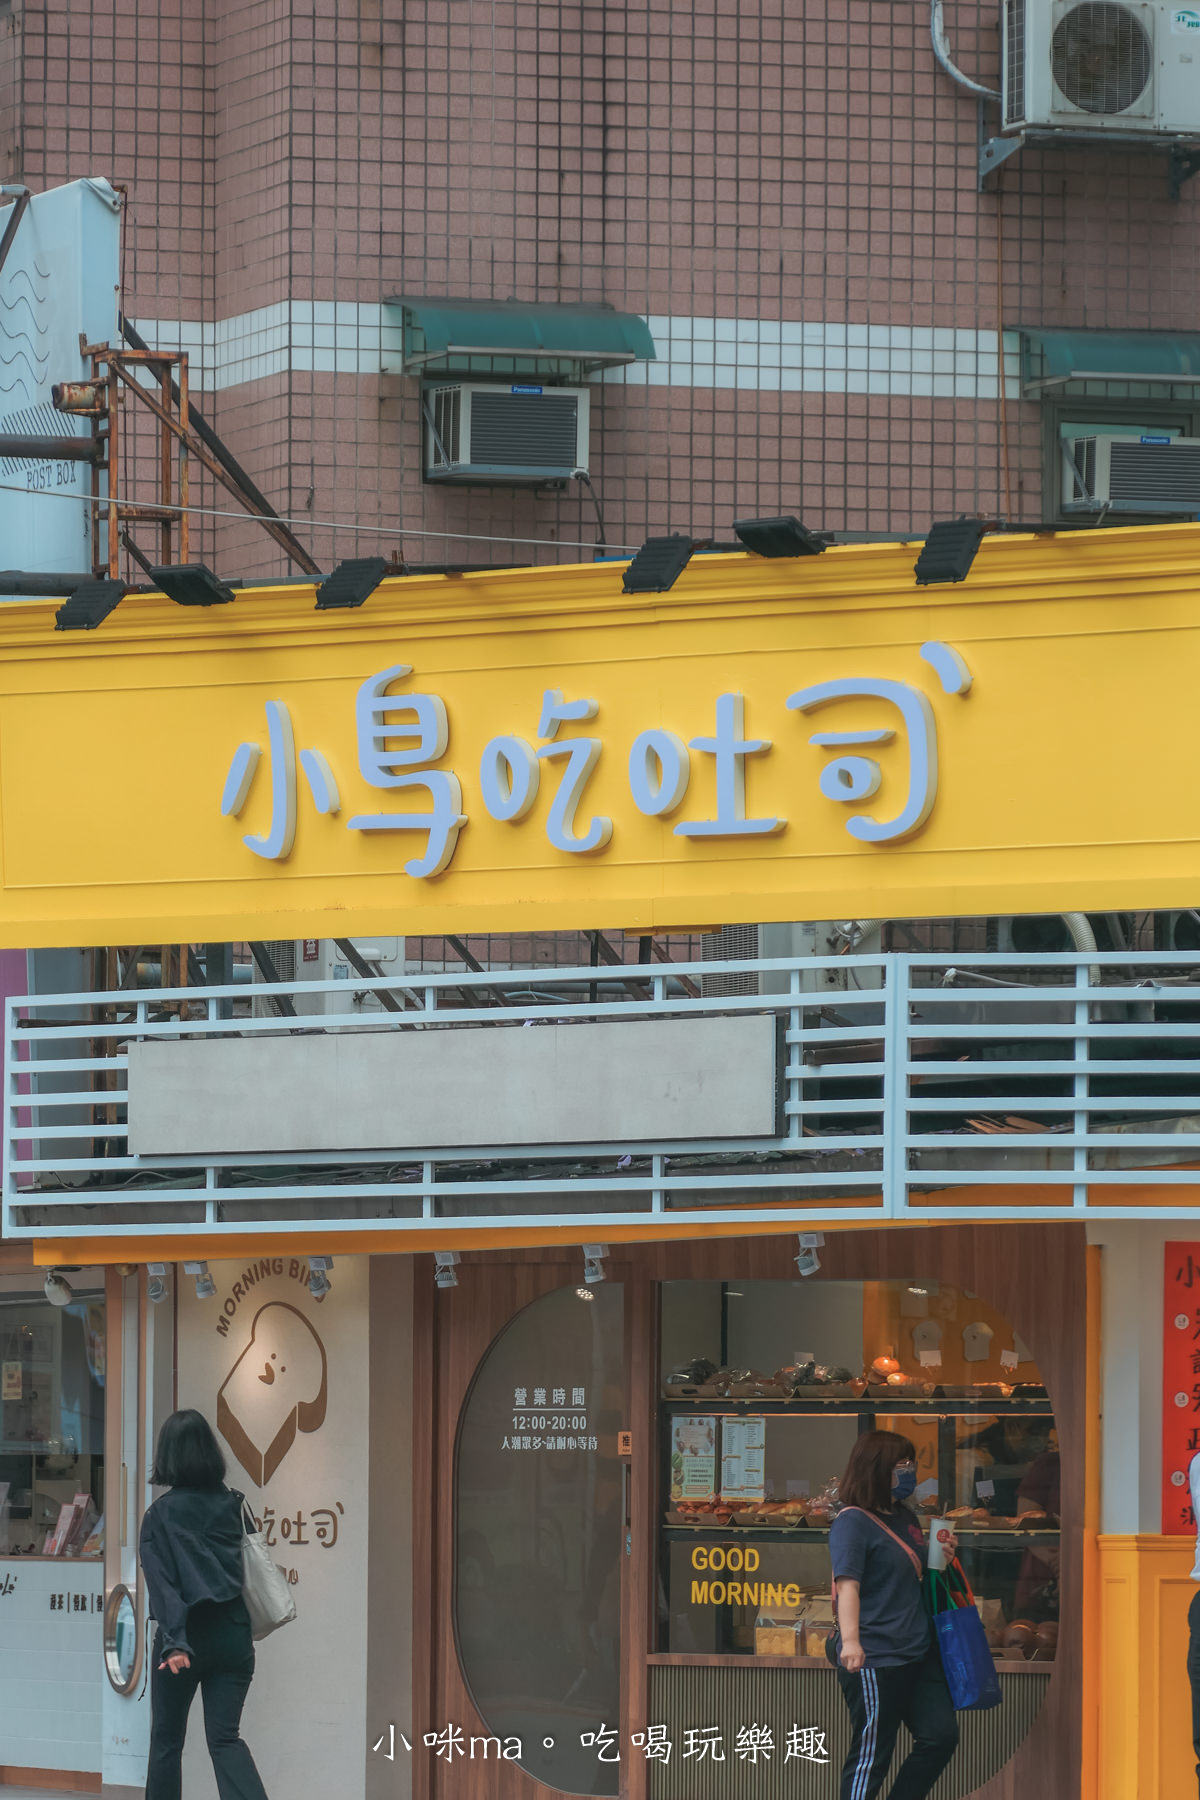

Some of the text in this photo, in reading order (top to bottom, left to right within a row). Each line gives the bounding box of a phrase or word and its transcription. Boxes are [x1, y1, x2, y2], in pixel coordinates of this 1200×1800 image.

[27, 460, 76, 489] POST BOX
[221, 641, 973, 879] 小鳥吃吐司
[216, 1258, 283, 1338] MORNING
[514, 1387, 585, 1406] 營業時間
[512, 1416, 587, 1430] 12:00-20:00
[691, 1546, 760, 1572] GOOD
[691, 1580, 801, 1608] MORNING
